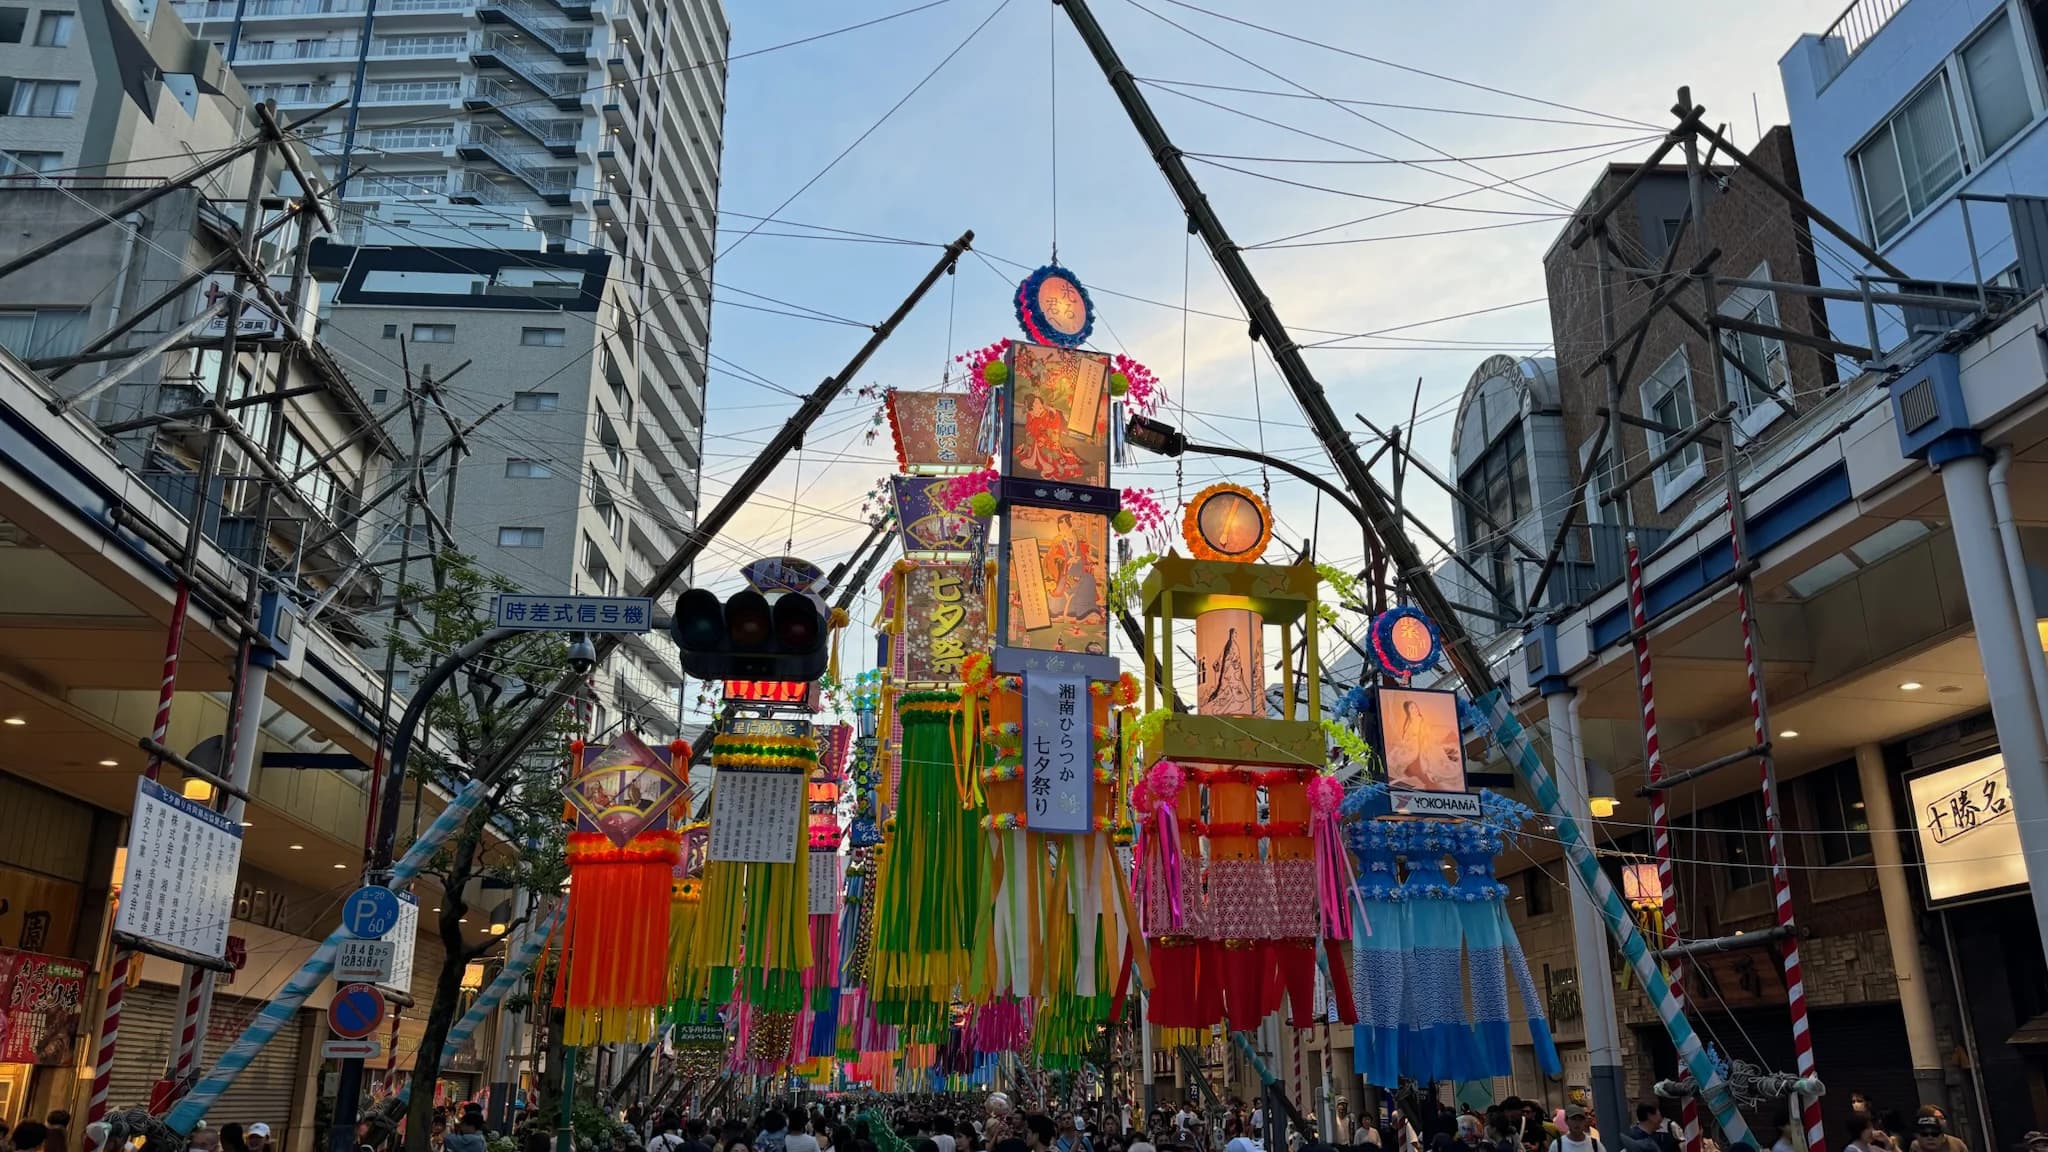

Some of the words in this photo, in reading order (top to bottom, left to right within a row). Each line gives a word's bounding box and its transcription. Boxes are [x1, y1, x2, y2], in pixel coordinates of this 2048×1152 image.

[935, 398, 957, 462] 星に願いを
[506, 602, 643, 624] 時差式信号機
[928, 570, 965, 674] 七夕祭
[733, 721, 797, 735] 星に願いを
[1059, 683, 1075, 782] 湘南ひらつか
[1032, 735, 1051, 817] 七夕祭り
[1414, 796, 1477, 812] YOKOHAMA
[1928, 779, 2012, 838] 十勝名
[353, 899, 378, 933] P
[368, 918, 385, 933] 60
